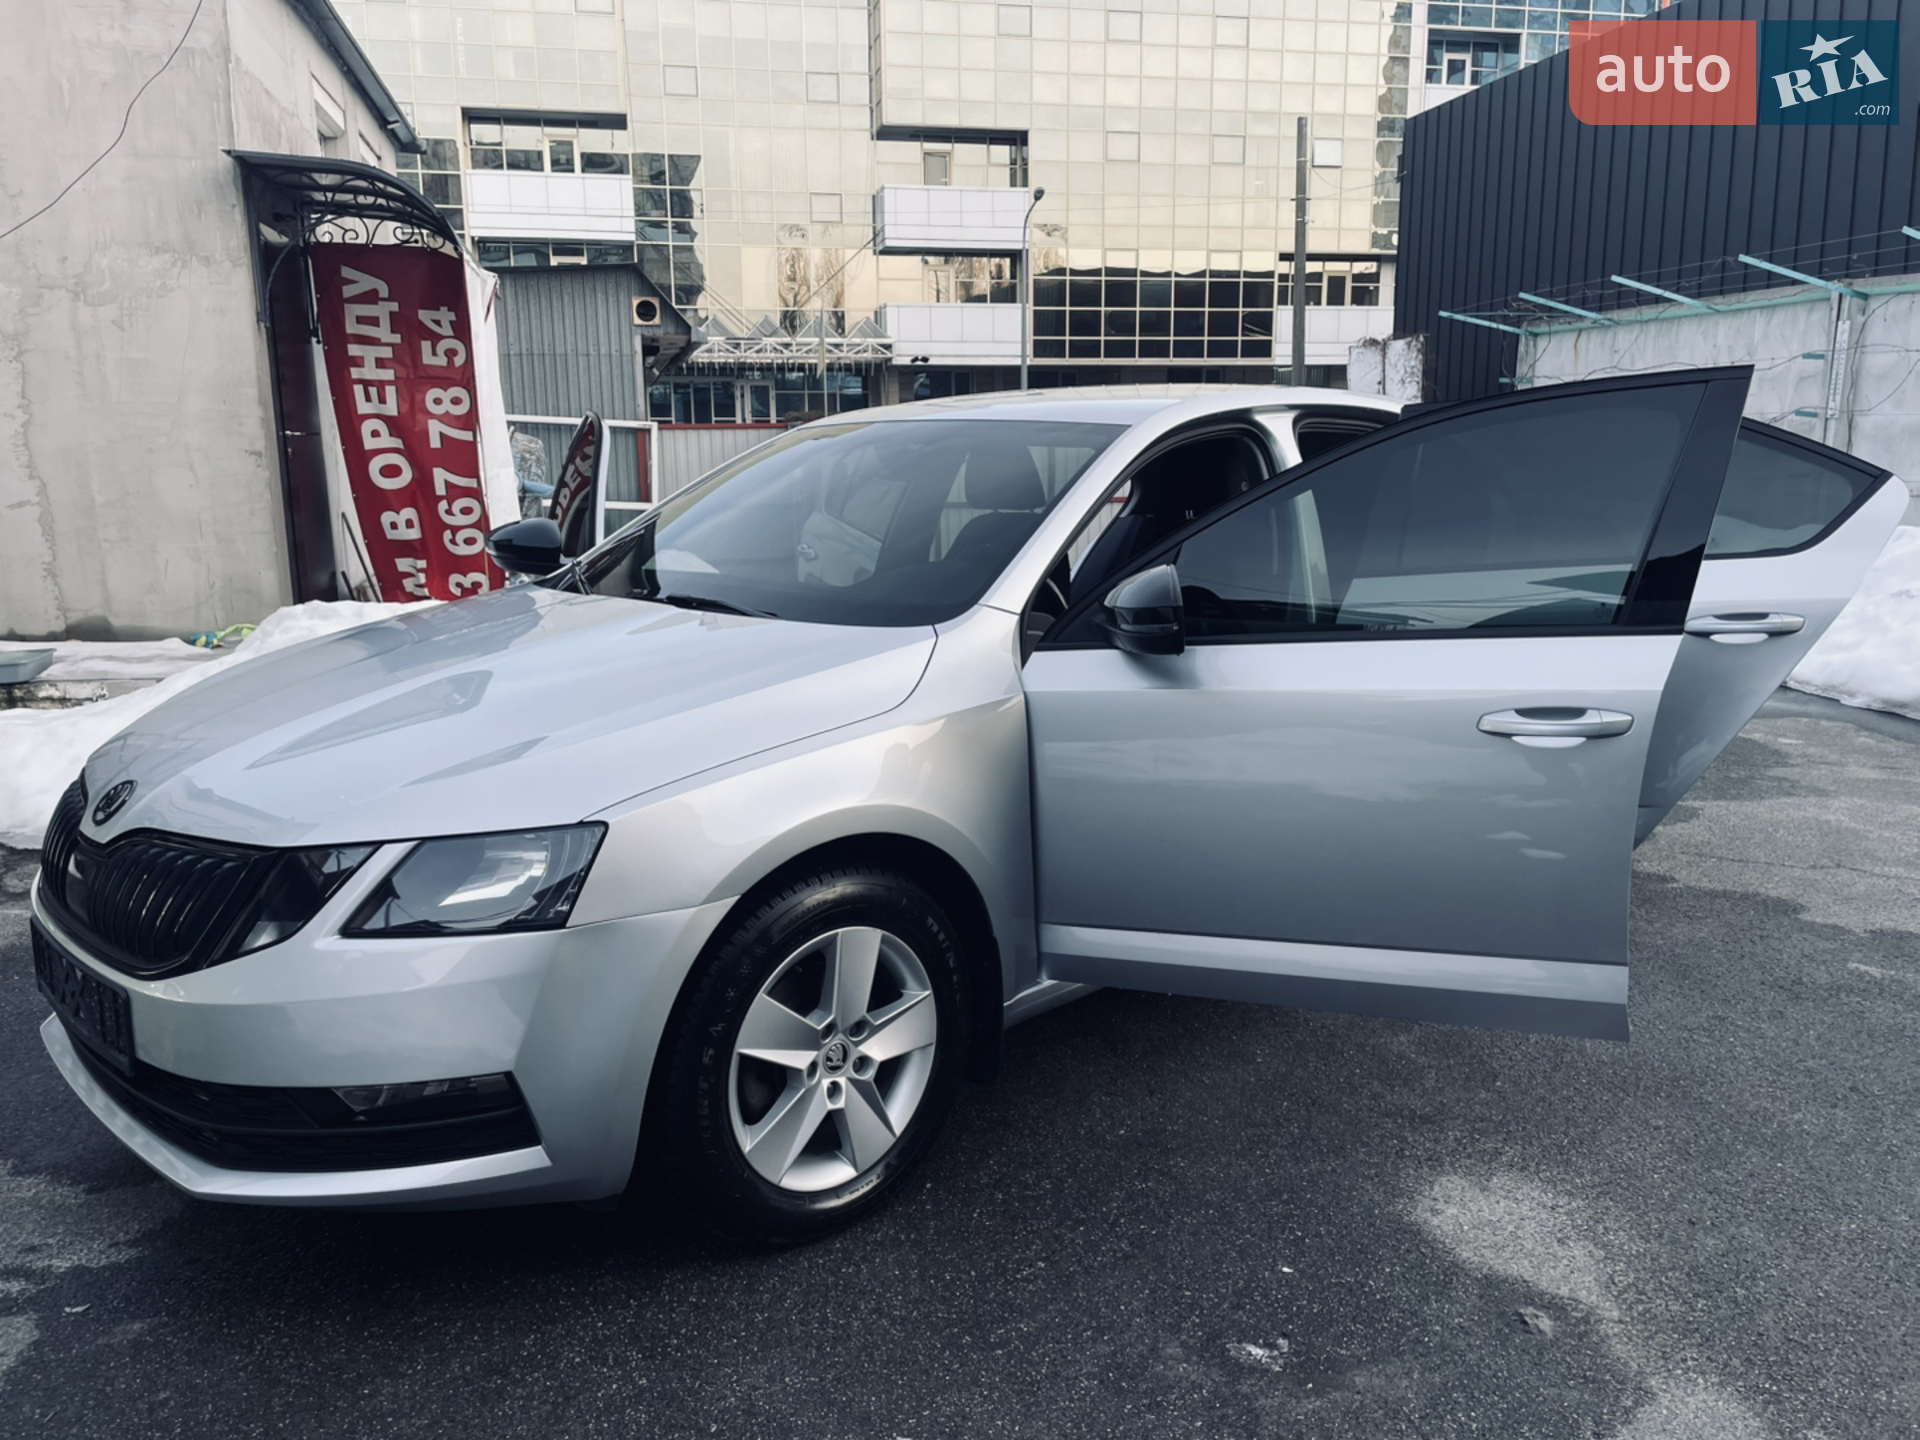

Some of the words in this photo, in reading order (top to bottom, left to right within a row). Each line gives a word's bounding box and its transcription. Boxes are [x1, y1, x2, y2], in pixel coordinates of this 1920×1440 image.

[417, 305, 468, 369] 54
[340, 264, 415, 490] ОРЕНДУ
[425, 385, 474, 449] 78
[380, 506, 423, 541] В
[432, 466, 486, 556] 667
[448, 572, 490, 598] 3
